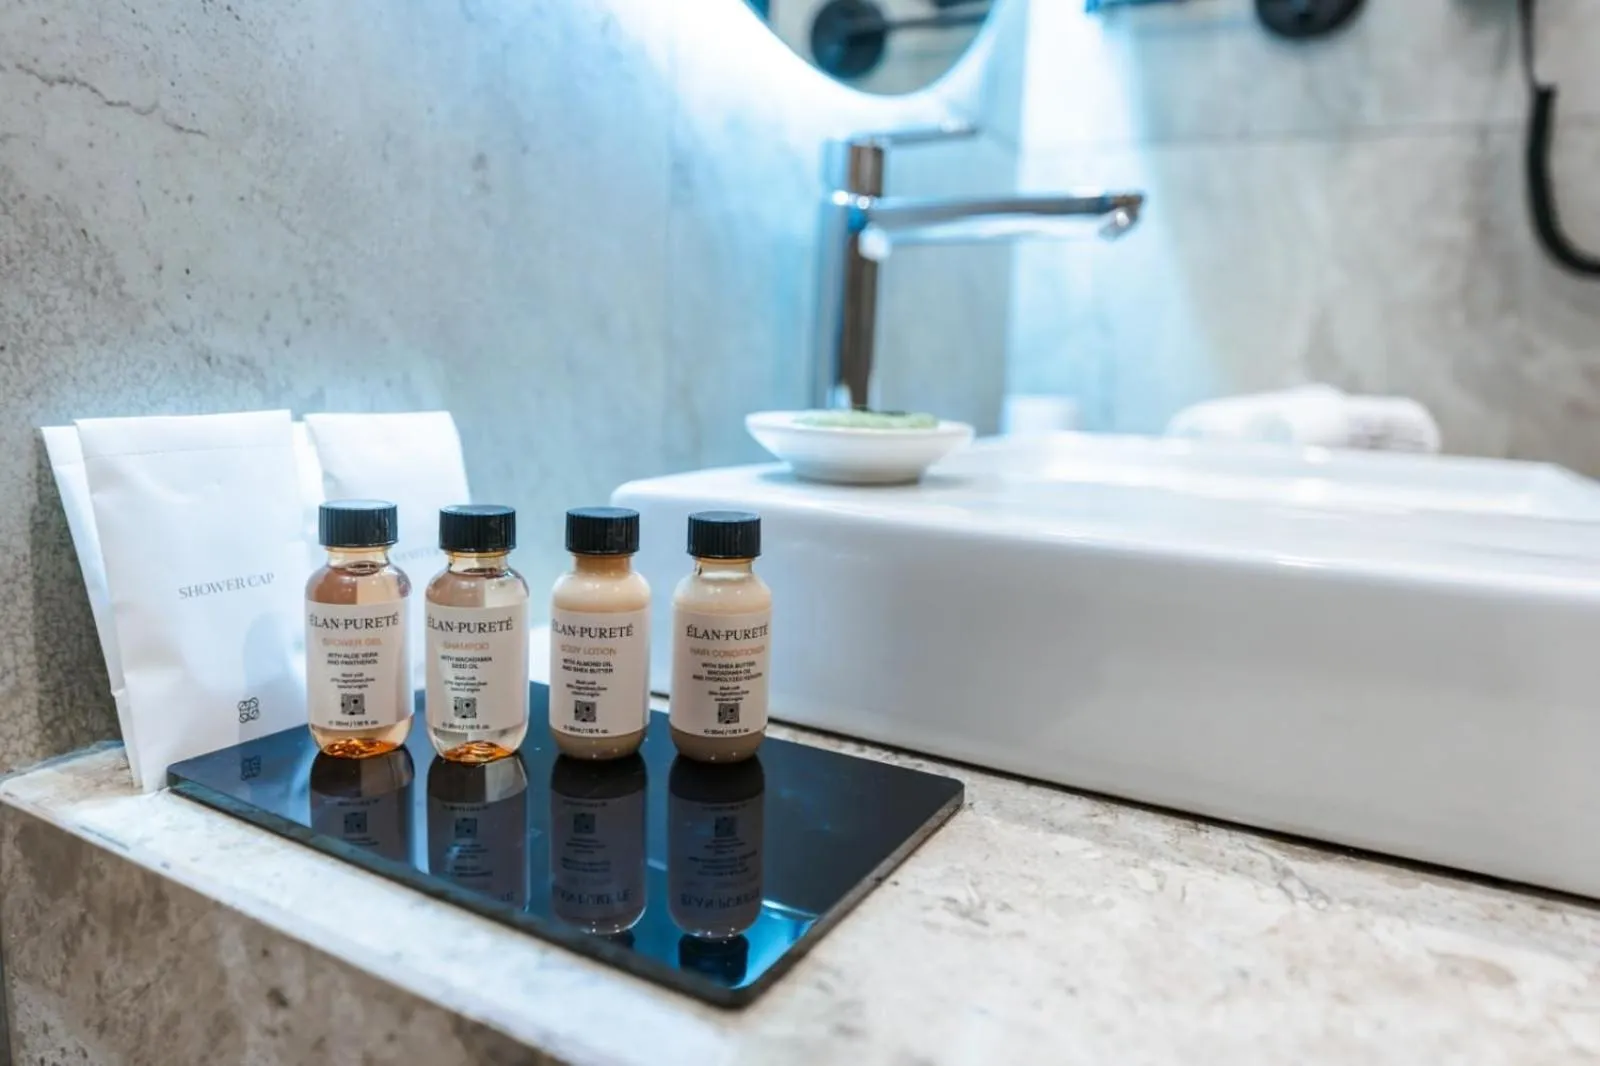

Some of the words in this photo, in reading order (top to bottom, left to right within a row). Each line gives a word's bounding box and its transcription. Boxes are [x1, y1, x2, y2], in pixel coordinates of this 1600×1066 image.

[177, 579, 245, 600] SHOWER
[247, 573, 275, 589] CAP
[583, 647, 617, 656] LOTION
